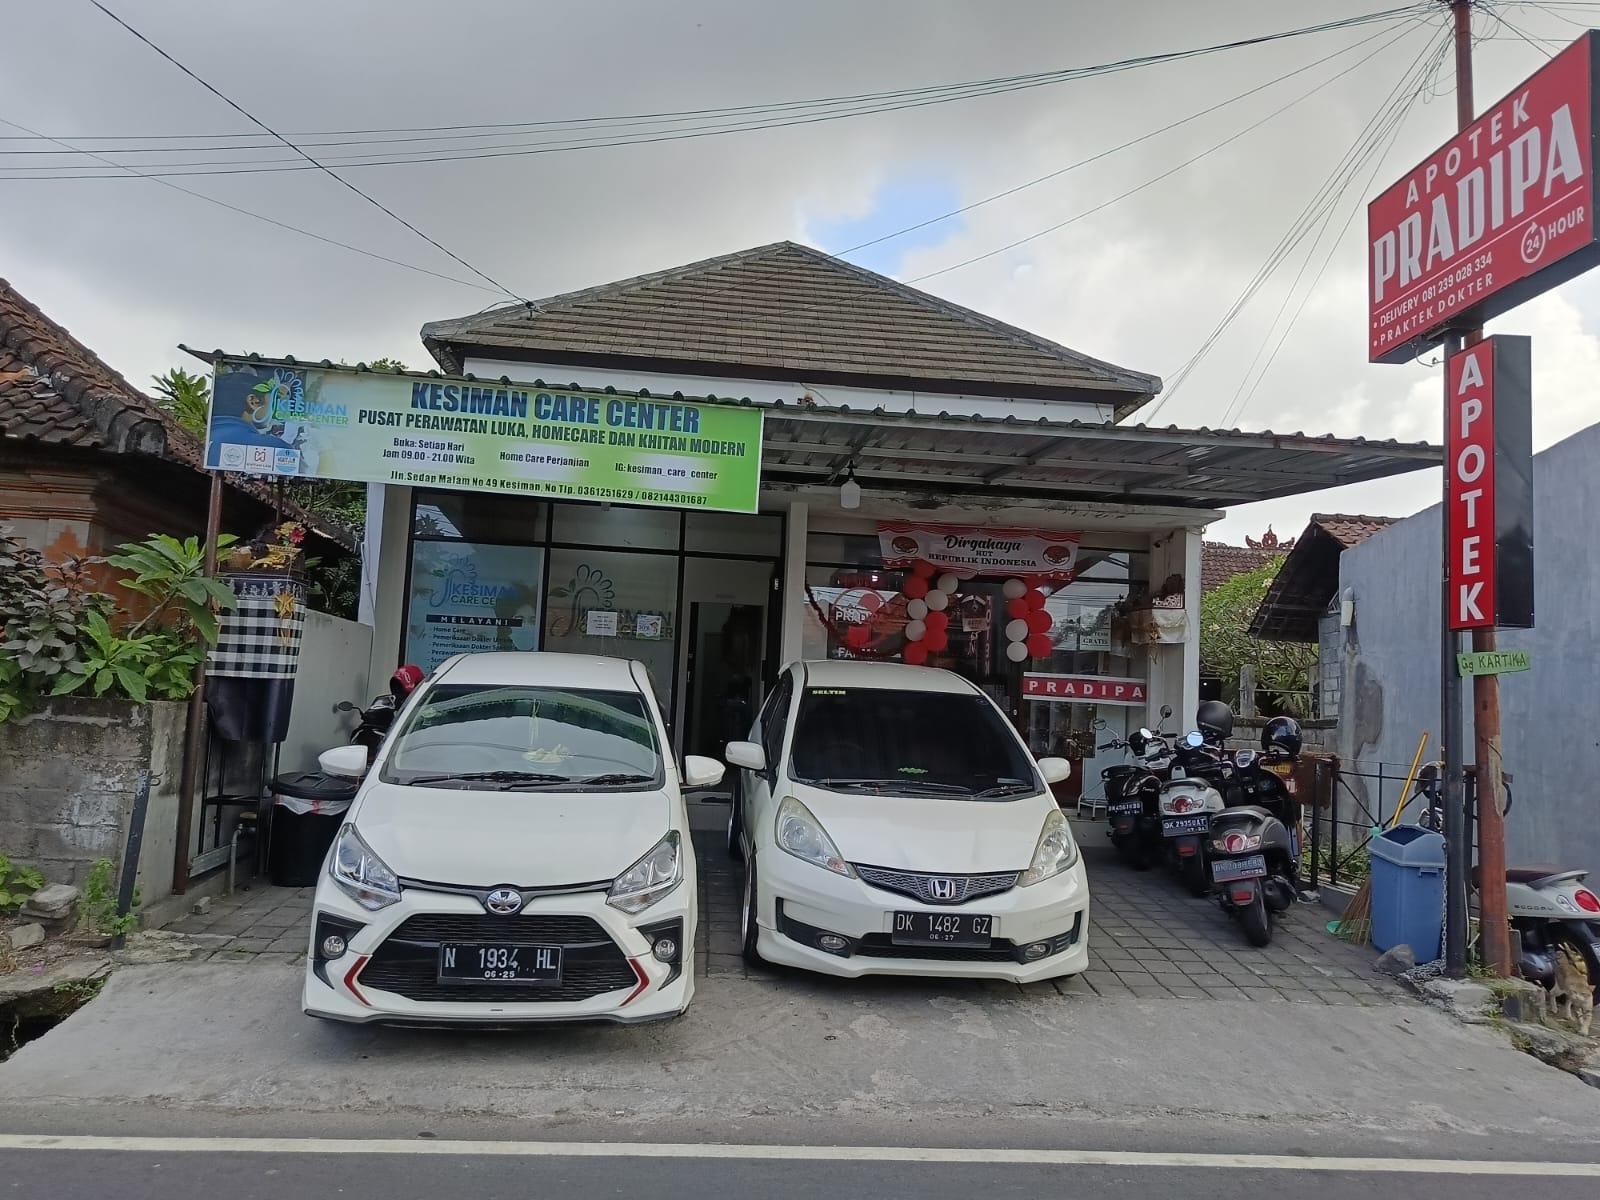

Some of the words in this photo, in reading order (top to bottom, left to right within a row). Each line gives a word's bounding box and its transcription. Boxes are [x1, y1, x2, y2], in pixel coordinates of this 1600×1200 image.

[1405, 90, 1530, 209] APOTEK
[1373, 103, 1583, 304] PRADIPA
[1526, 233, 1540, 251] 24
[1547, 206, 1585, 240] HOUR
[1379, 298, 1419, 328] DELIVERY
[1422, 286, 1437, 304] 081
[1438, 274, 1453, 296] 239
[1455, 262, 1473, 286] 028
[1474, 252, 1493, 275] 334
[1379, 305, 1434, 346] PRAKTEK
[1438, 272, 1494, 313] DOKTER
[276, 401, 347, 417] KESIMAN
[411, 381, 528, 418] KESIMAN
[534, 392, 599, 425] CARE
[606, 399, 700, 434] CENTER
[358, 409, 403, 427] PUSAT
[405, 413, 487, 435] PERAWATAN
[491, 422, 529, 439] LUKA,
[532, 427, 605, 445] HOMECARE
[609, 430, 635, 447] DAN
[638, 433, 687, 452] KHITAN
[689, 438, 745, 457] MODERN
[393, 438, 417, 448] Buka:
[418, 439, 446, 452] Setiap
[447, 441, 465, 452] Hari
[383, 449, 400, 459] Jam
[401, 450, 425, 460] 09.00
[432, 453, 454, 463] 21.00
[455, 454, 475, 464] Wita
[500, 451, 524, 463] Home
[525, 453, 545, 464] Care
[546, 455, 590, 468] Perjanjian
[439, 474, 470, 486] Malam
[472, 476, 484, 487] No
[485, 478, 498, 488] 49
[545, 483, 557, 493] No
[1457, 352, 1486, 622] APOTEK
[928, 553, 979, 564] REPUBLIK
[980, 558, 1037, 567] INDONESIA
[451, 595, 479, 605] CARE
[440, 615, 509, 627] MELAYANI
[1460, 655, 1474, 672] Gg
[1478, 654, 1527, 670] KARTIKA
[1029, 680, 1143, 698] PRADIPA
[897, 914, 914, 931] DK
[928, 915, 960, 933] 1482
[972, 918, 990, 934] GZ
[444, 947, 456, 968] N
[479, 948, 519, 969] 1934
[536, 949, 556, 969] HL
